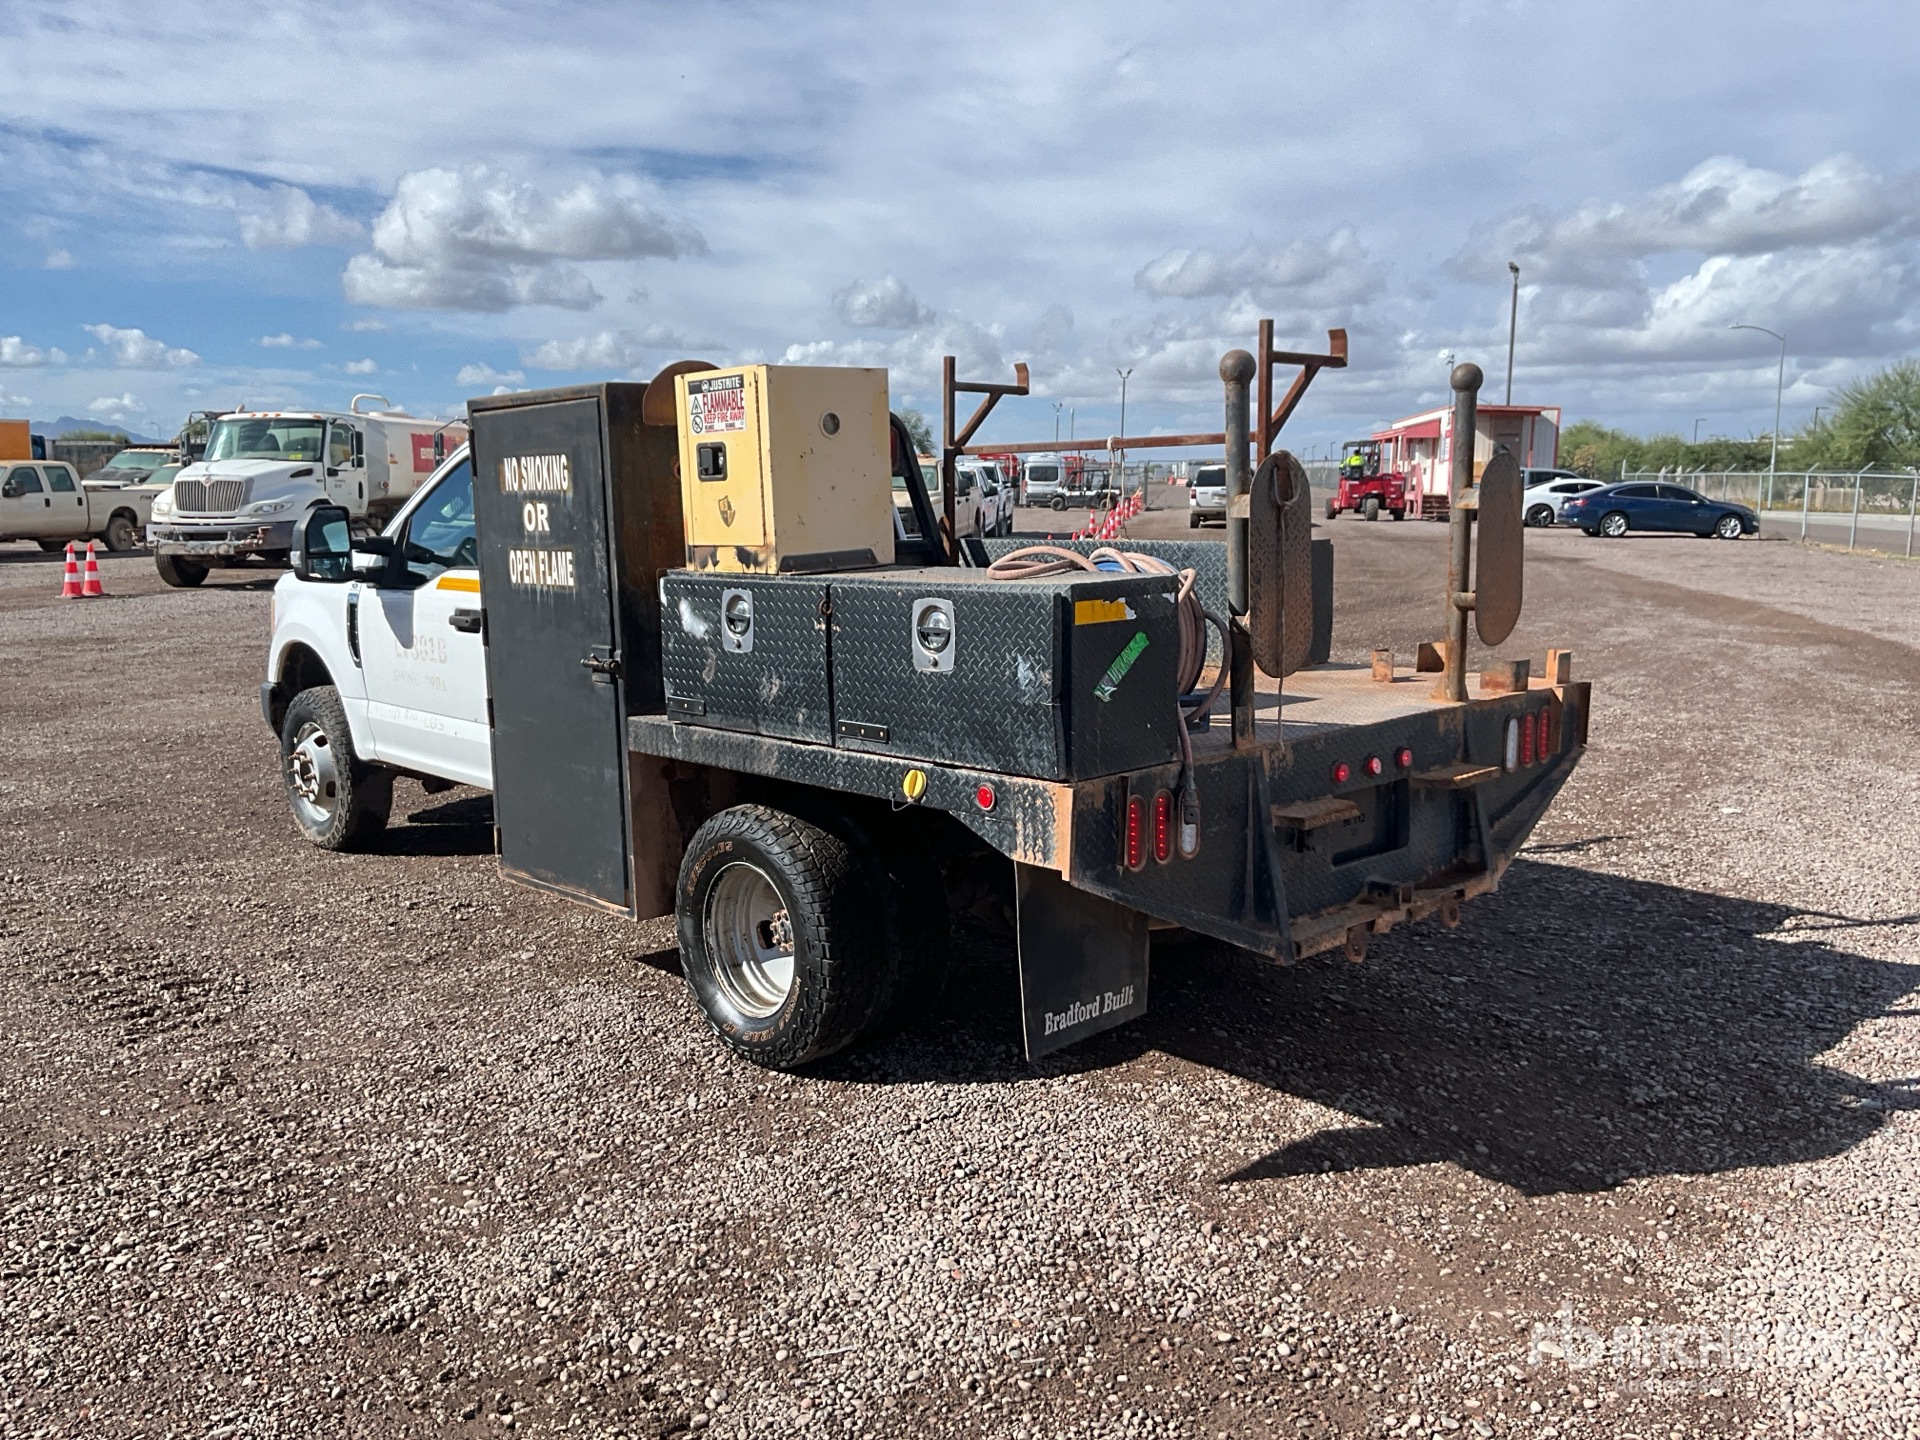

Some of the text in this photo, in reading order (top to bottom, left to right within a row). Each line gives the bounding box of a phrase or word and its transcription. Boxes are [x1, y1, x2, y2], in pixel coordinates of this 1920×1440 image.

[709, 377, 740, 391] JUSTRITE
[702, 390, 744, 413] FLAMMABLE
[704, 410, 744, 424] KEEP FIRE AWAY
[504, 454, 569, 491] NO SMOKING
[523, 503, 550, 532] OR
[509, 549, 574, 586] OPEN FLAME
[1044, 984, 1134, 1036] Bradford Built
